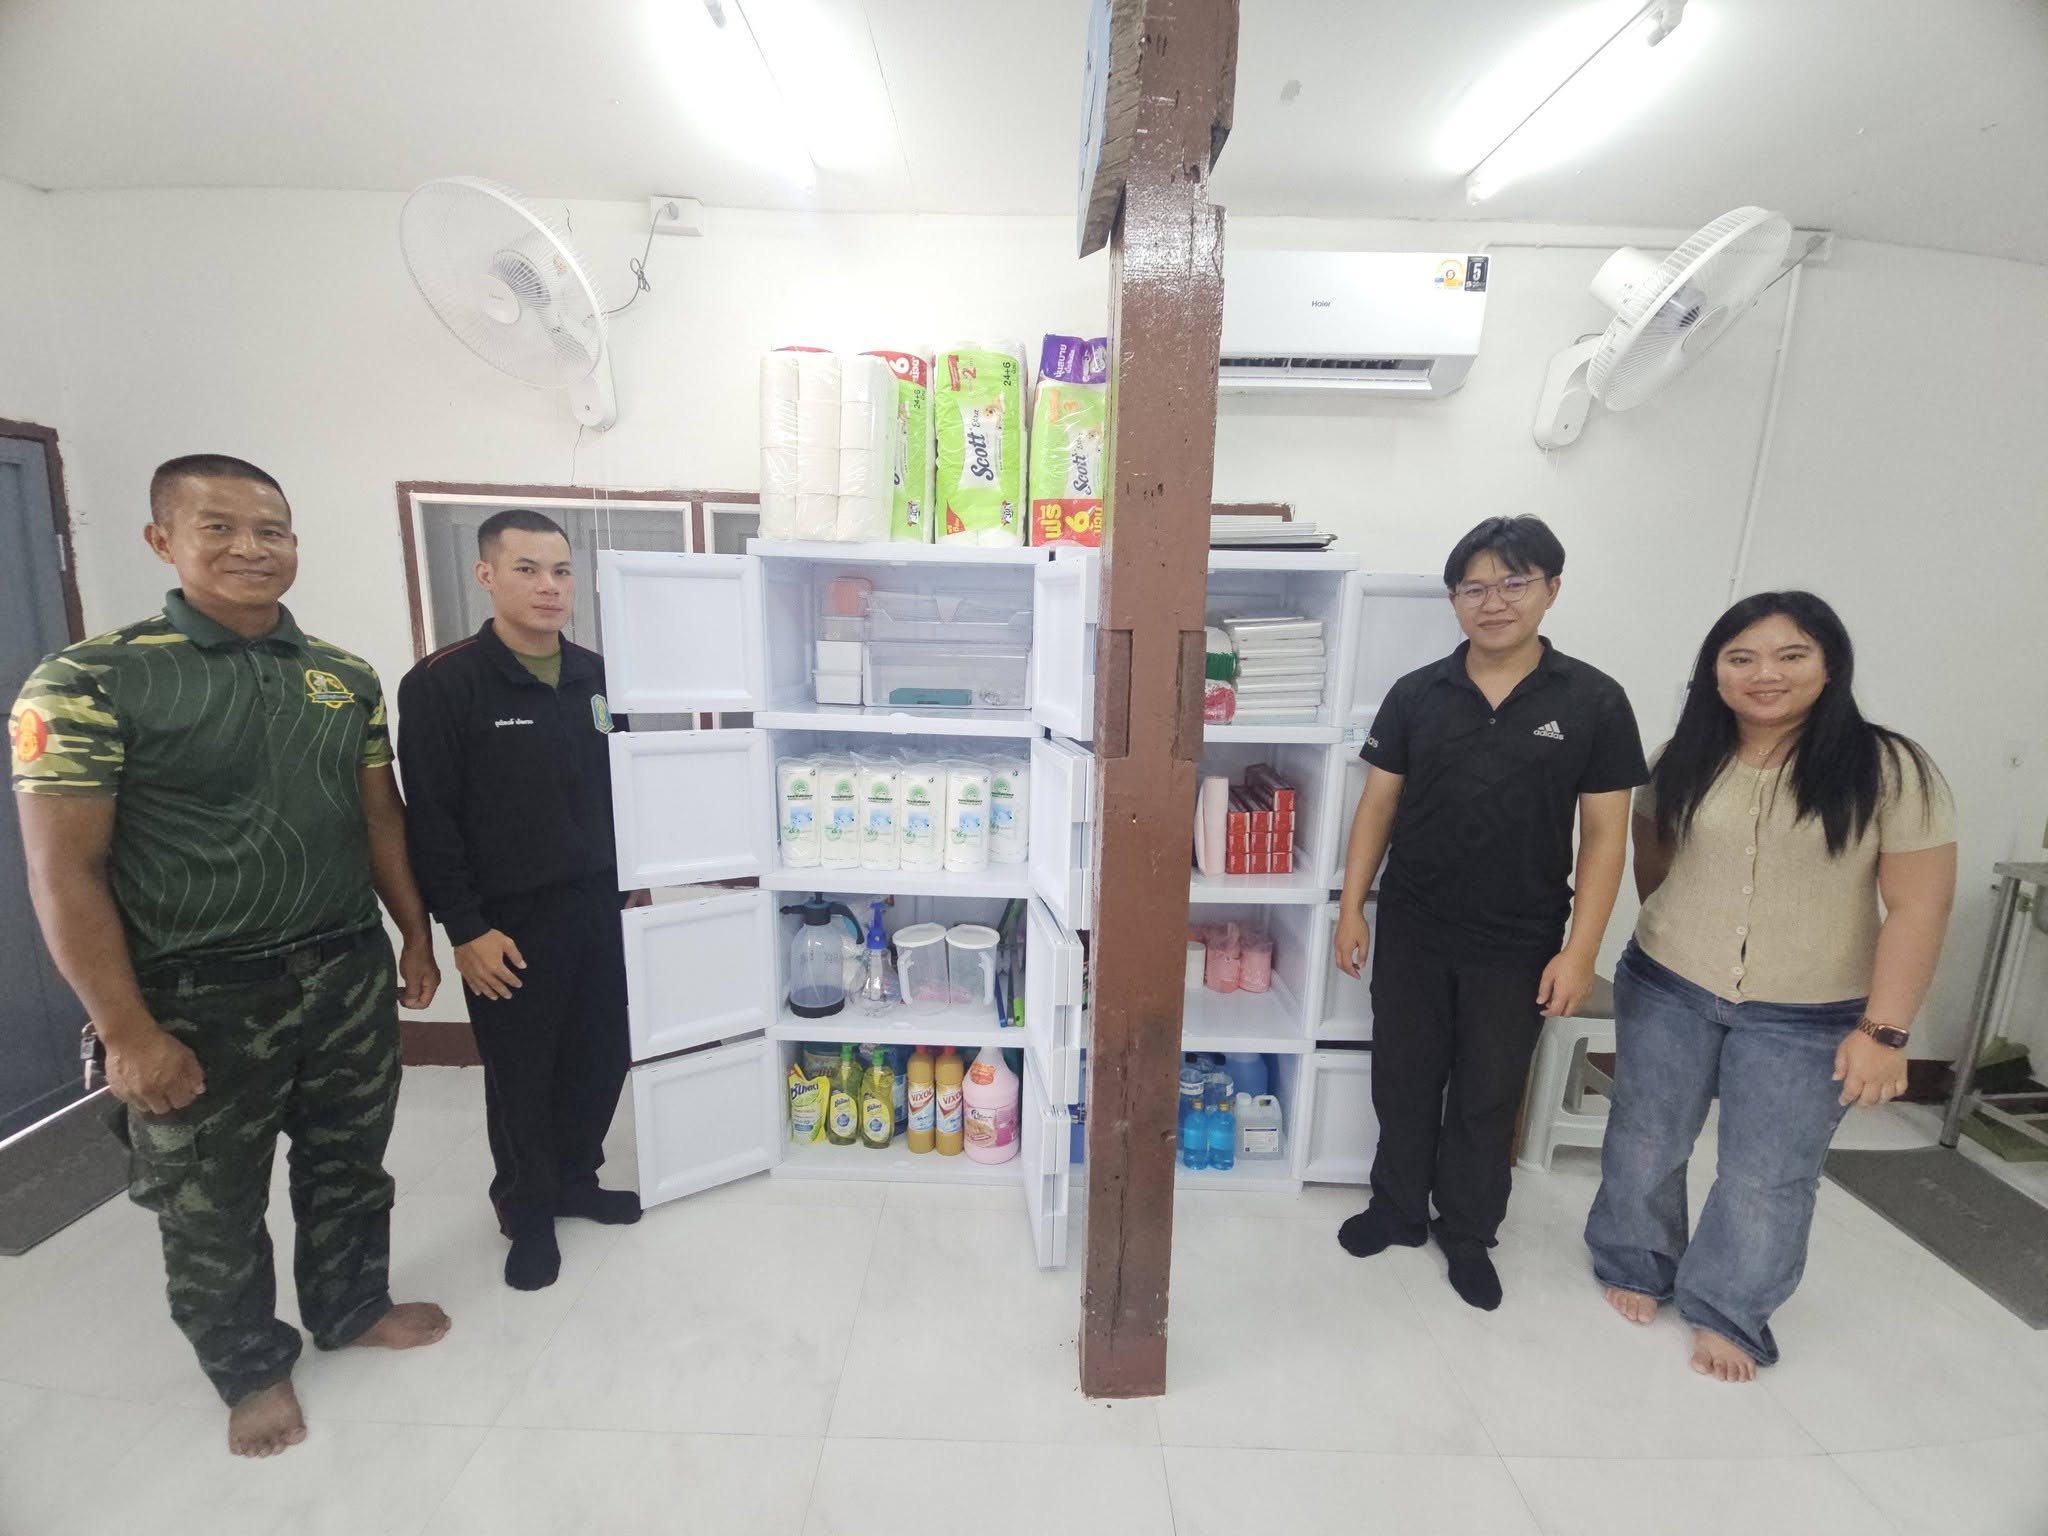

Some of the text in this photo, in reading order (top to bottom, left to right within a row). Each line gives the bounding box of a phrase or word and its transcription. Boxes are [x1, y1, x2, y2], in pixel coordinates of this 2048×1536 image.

[1472, 262, 1482, 281] 5
[1311, 300, 1331, 308] Haier
[889, 356, 910, 374] 6
[1002, 361, 1011, 387] 24+6
[967, 432, 994, 481] Scott
[1039, 503, 1062, 539] ฟรี
[1064, 510, 1090, 533] 6
[1532, 728, 1565, 741] adidas
